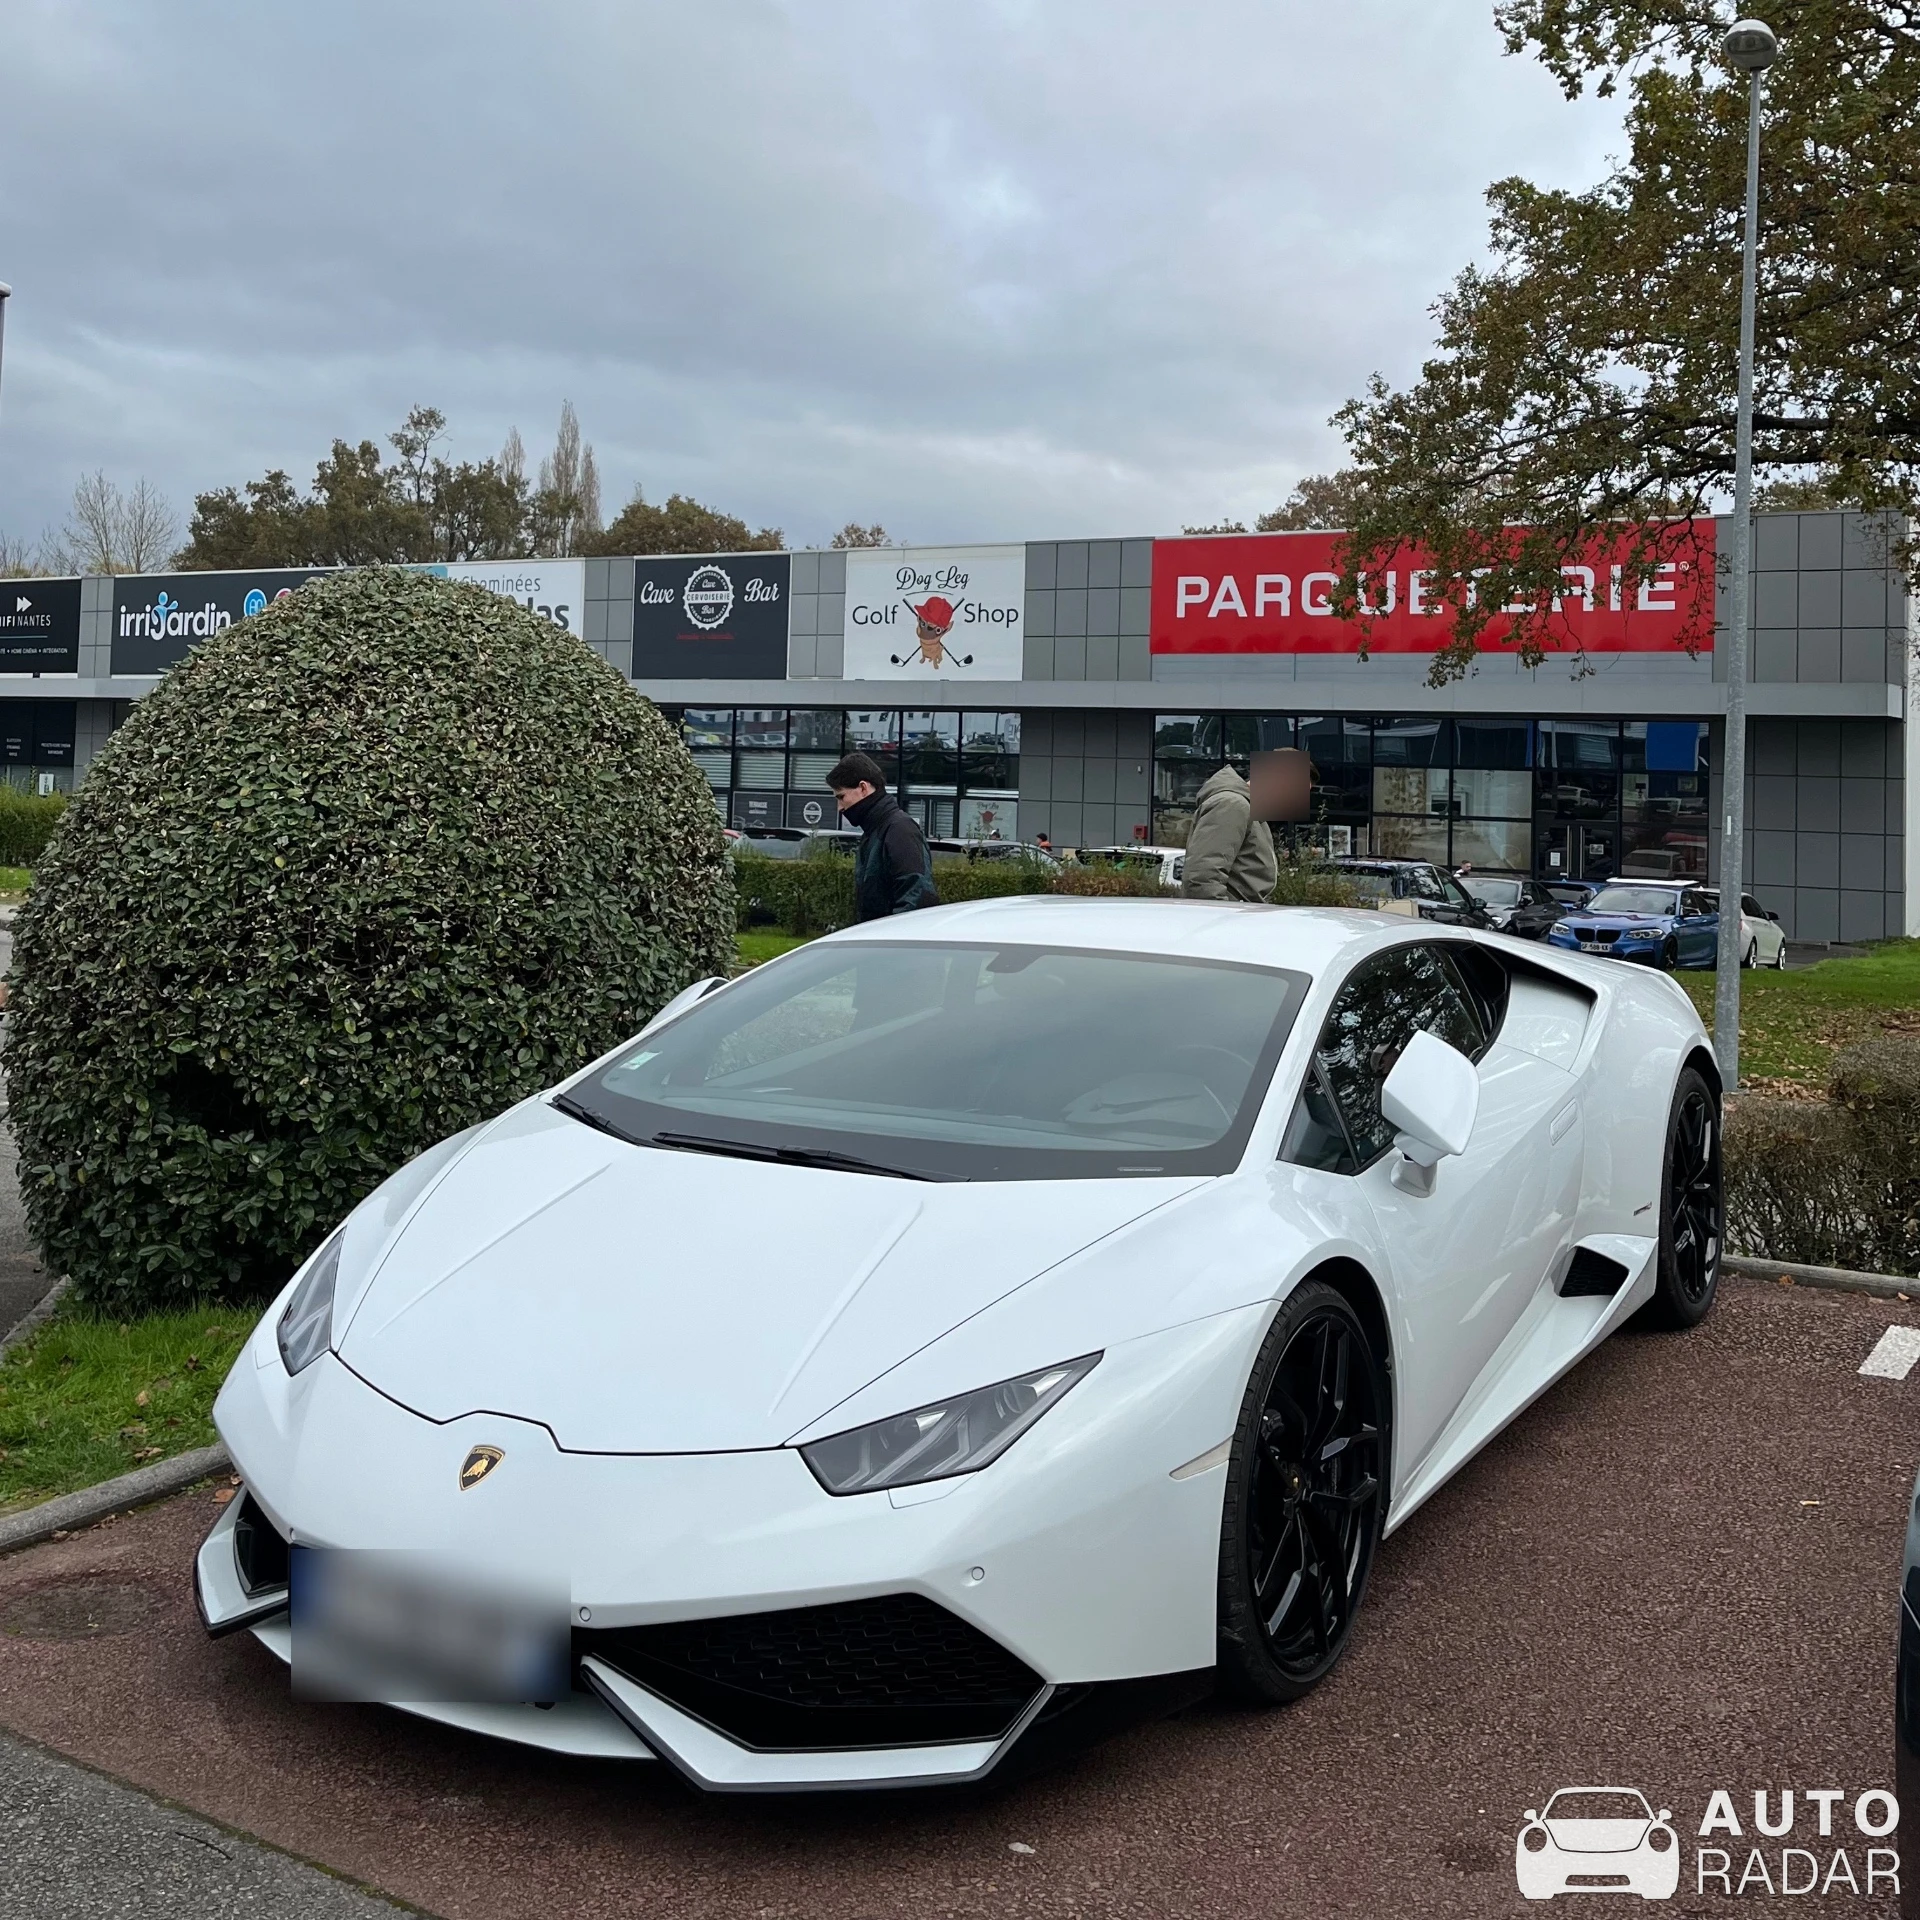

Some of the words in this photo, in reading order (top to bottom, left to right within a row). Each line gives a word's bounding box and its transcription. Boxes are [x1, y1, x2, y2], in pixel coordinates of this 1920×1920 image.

[744, 577, 780, 602] Bar
[896, 566, 932, 590] Dog
[935, 565, 970, 590] Leg
[640, 580, 674, 604] Cave
[686, 593, 730, 602] CERVOISERIE
[17, 614, 51, 627] NANTES
[852, 605, 899, 625] Golf
[964, 603, 1019, 628] Shop
